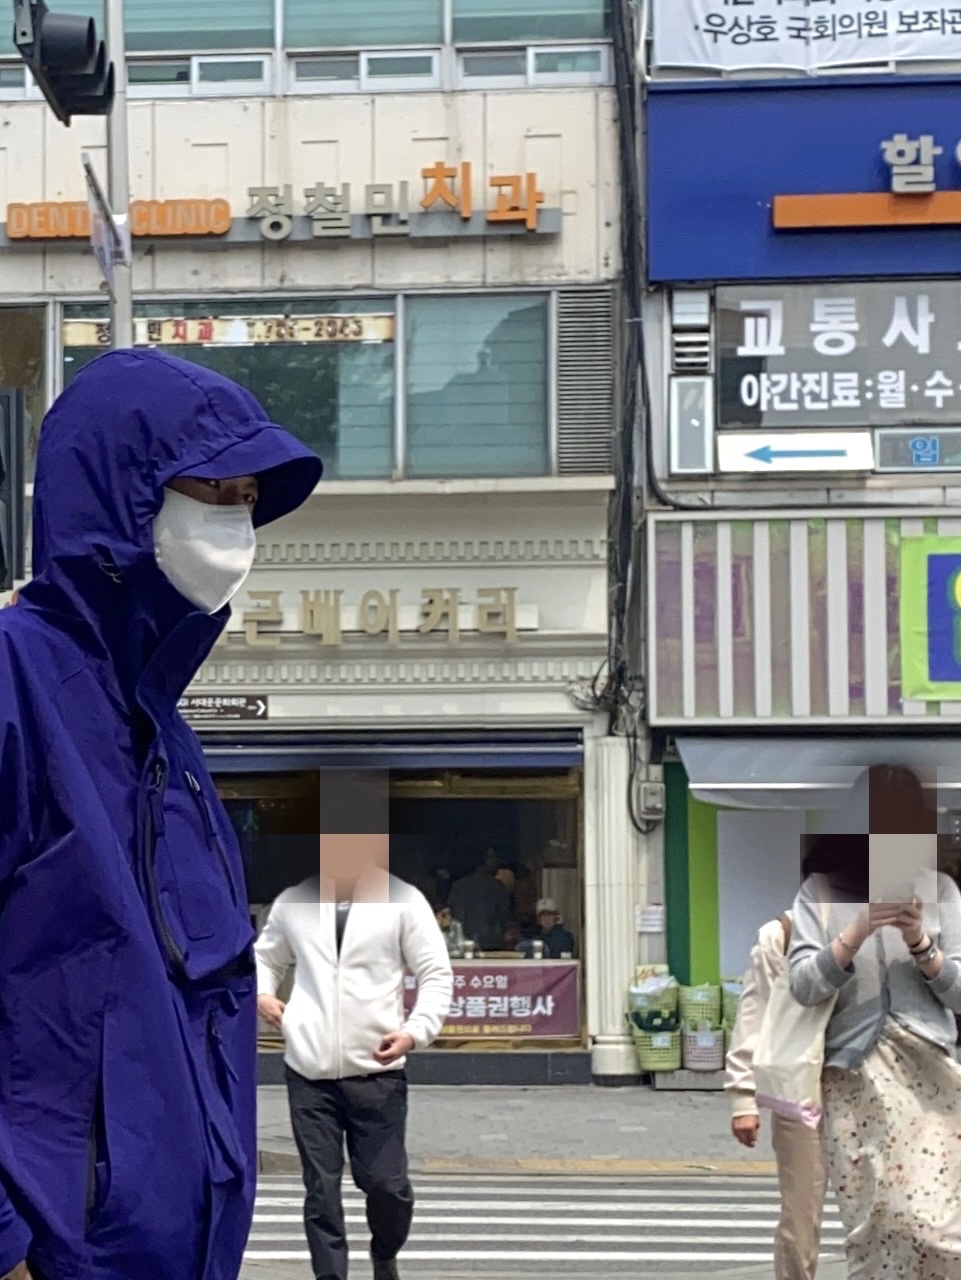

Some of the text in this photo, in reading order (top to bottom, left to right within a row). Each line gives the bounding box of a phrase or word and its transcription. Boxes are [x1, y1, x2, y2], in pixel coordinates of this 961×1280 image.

[786, 10, 888, 46] 국회의원
[880, 133, 961, 193] 할
[9, 202, 227, 233] DENT CLINIC
[736, 294, 961, 357] 교통사
[216, 587, 519, 647] 근베이커리
[469, 975, 509, 989] 수요일
